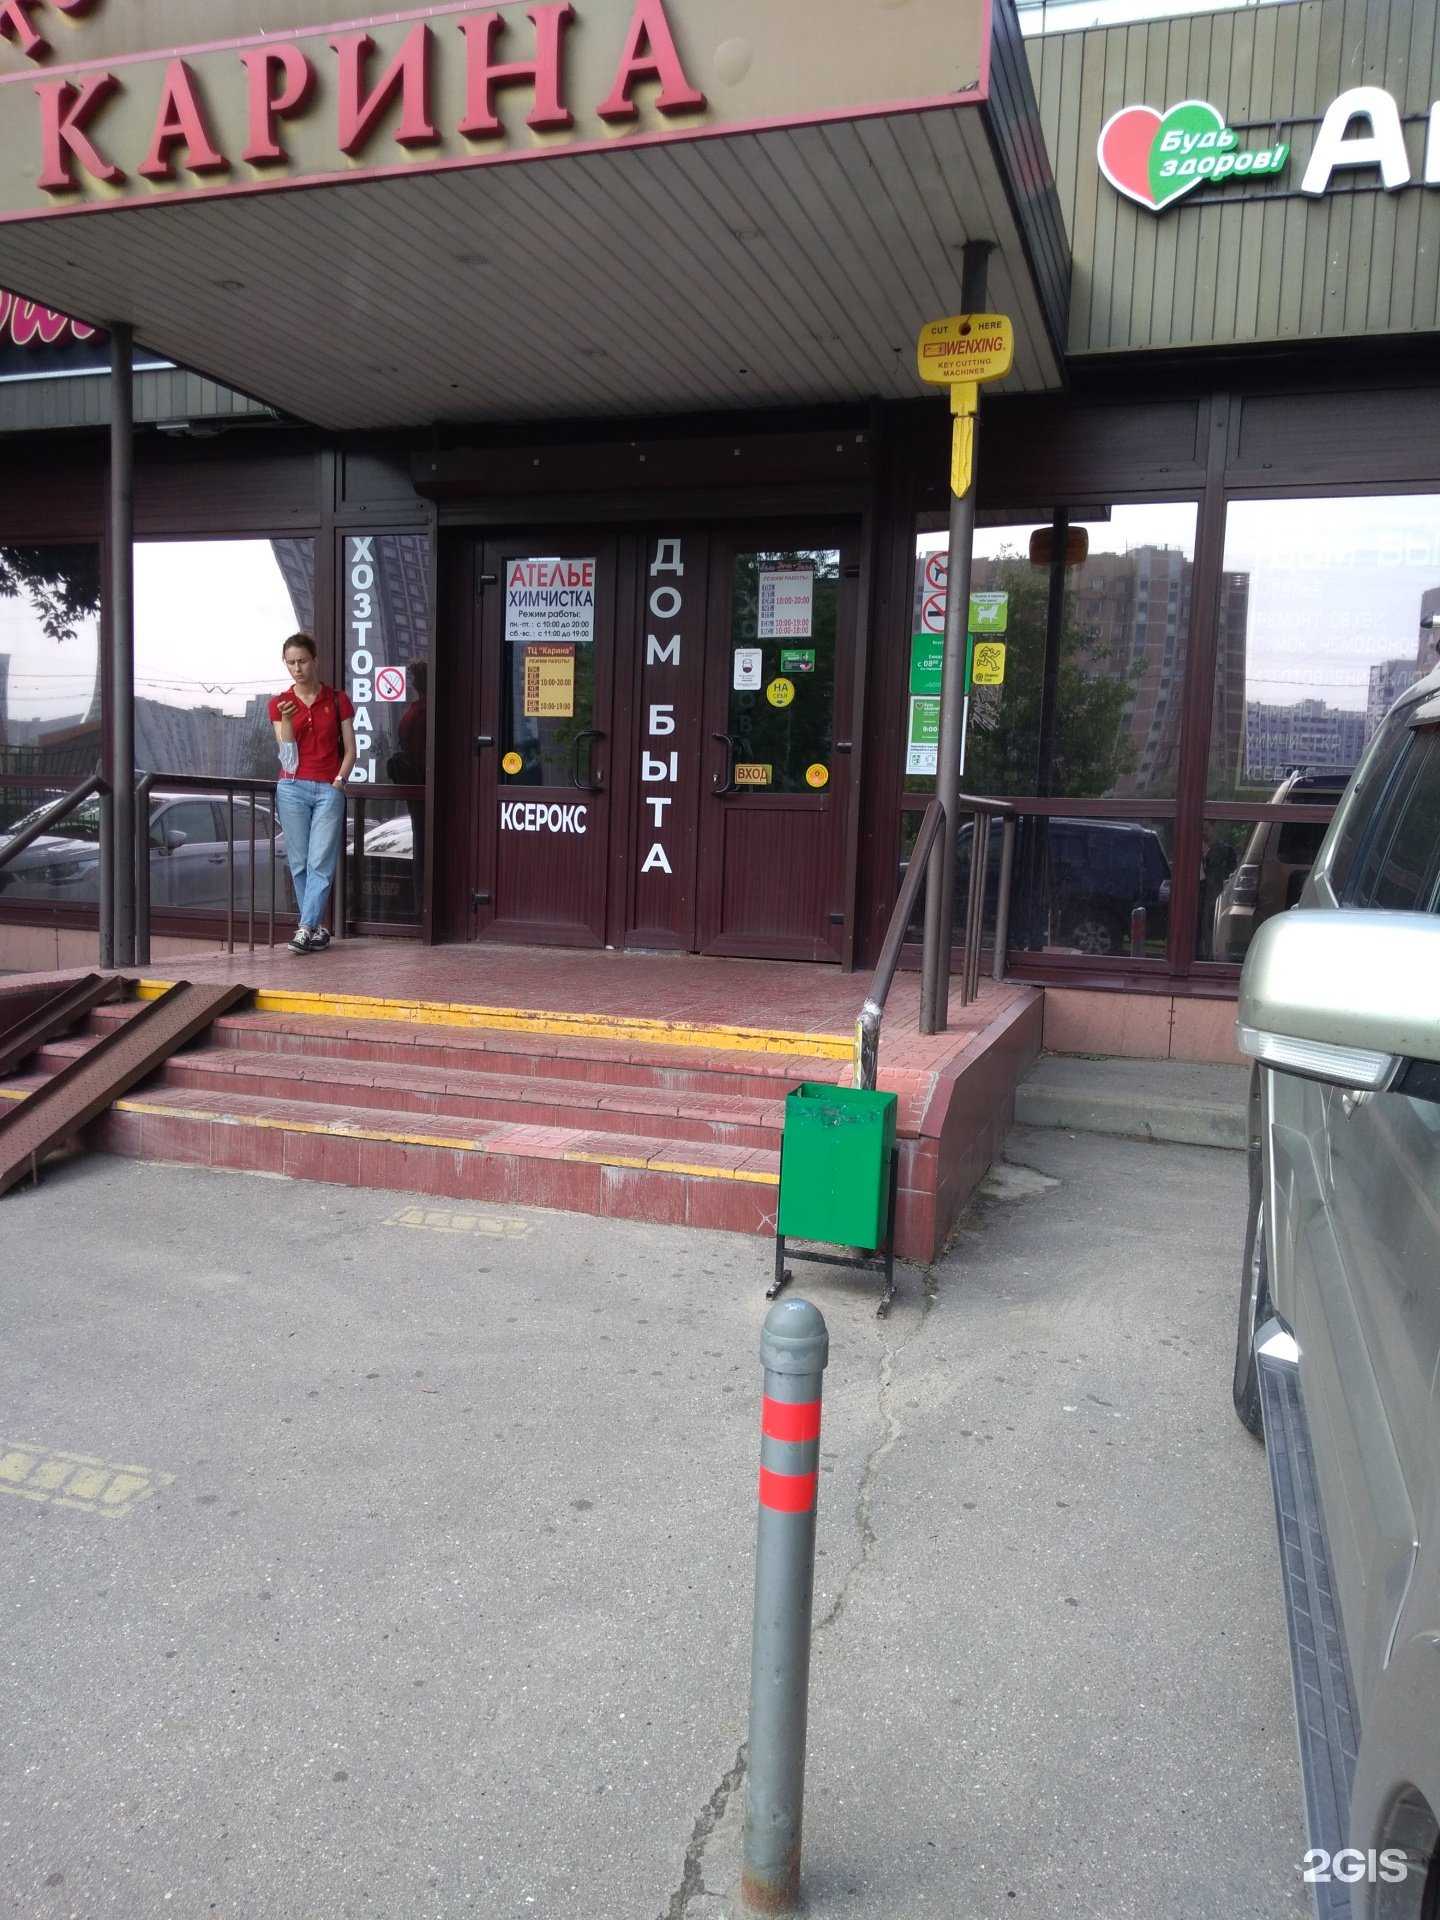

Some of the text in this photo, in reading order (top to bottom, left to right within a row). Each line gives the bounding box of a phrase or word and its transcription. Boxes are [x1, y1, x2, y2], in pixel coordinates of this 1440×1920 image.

[36, 0, 707, 193] КАРИНА
[1160, 130, 1234, 154] Будь
[1302, 86, 1440, 197] А
[1160, 146, 1285, 177] здоров!
[931, 321, 1002, 335] CUT HERE
[946, 337, 1004, 356] WENXING
[943, 368, 985, 377] MACHINES
[956, 358, 991, 367] CUTTING
[509, 563, 593, 587] АТЕЛЬЕ
[509, 590, 593, 607] ХИМЧИСТКА
[518, 610, 581, 618] Режим работы:
[348, 536, 376, 783] ХОЗТОВАРЫ
[774, 683, 788, 692] НА
[641, 538, 684, 874] ДОМ БЫТА
[738, 768, 767, 781] ВХОД
[501, 803, 587, 834] КСЕРОКС
